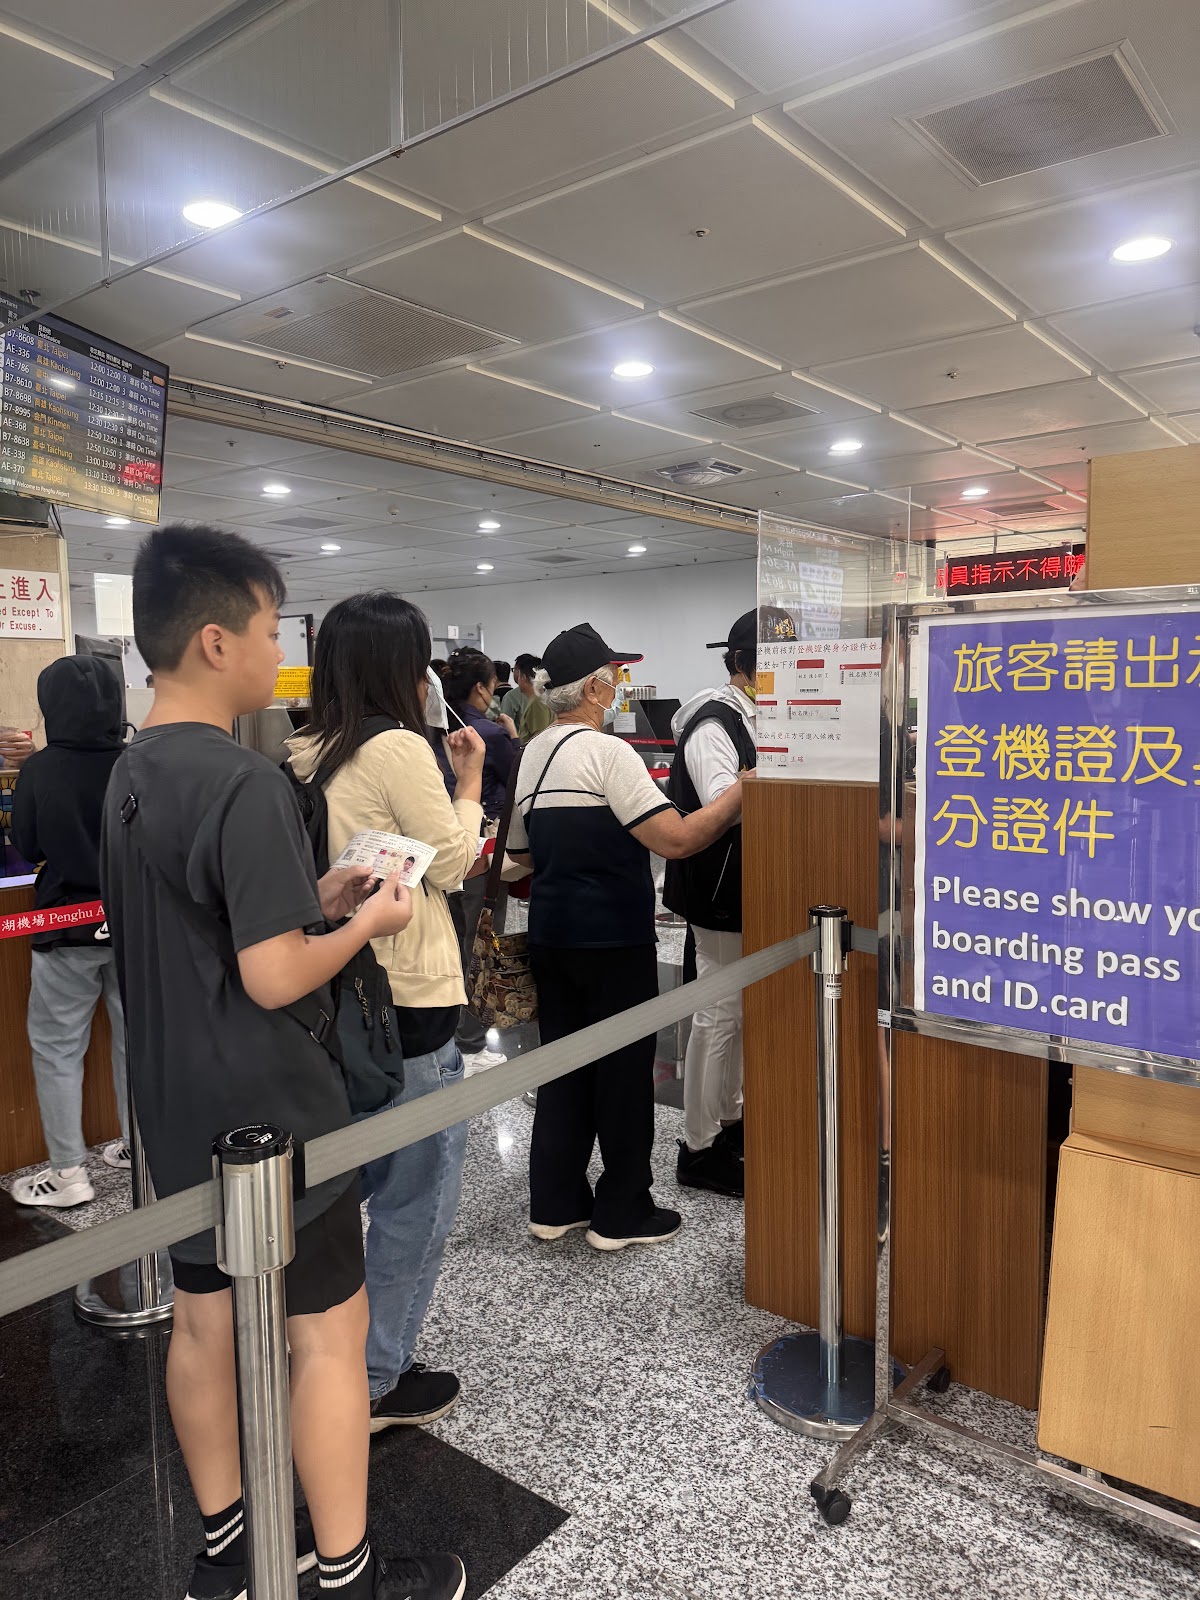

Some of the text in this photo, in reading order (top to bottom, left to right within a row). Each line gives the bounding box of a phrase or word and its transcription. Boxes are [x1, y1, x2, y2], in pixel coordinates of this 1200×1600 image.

[6, 342, 30, 359] AE-336
[37, 354, 49, 367] 高雄
[51, 360, 81, 380] Kaohsiung
[90, 375, 104, 388] 12:00
[106, 382, 120, 393] 12:00
[122, 388, 126, 396] 3
[140, 395, 147, 404] On
[148, 398, 159, 408] Time
[6, 358, 29, 374] AE-786
[90, 389, 104, 401] 12:15
[106, 395, 119, 406] 12:15
[139, 408, 146, 416] On
[147, 411, 159, 420] Time
[51, 346, 69, 362] Taipei
[91, 362, 105, 375] 12:00
[107, 369, 121, 381] 12:00
[123, 375, 127, 383] 9
[141, 383, 148, 391] On
[148, 386, 160, 396] Time
[4, 402, 31, 418] B7-8995
[34, 412, 47, 423] 金門
[48, 416, 71, 430] Kinmen
[88, 429, 102, 440] 12:50
[103, 434, 117, 445] 12:50
[137, 445, 144, 453] On
[145, 447, 157, 456] Time
[5, 373, 32, 390] B7-8610
[50, 388, 67, 403] Taipei
[89, 402, 103, 414] 12:30
[138, 420, 145, 428] On
[146, 423, 158, 433] Time
[5, 388, 32, 404] B7-8698
[35, 398, 47, 410] 高雄
[49, 403, 79, 421] Kaohsiung
[88, 416, 102, 427] 12:30
[104, 421, 118, 432] 12:30
[138, 432, 145, 441] On
[146, 435, 157, 445] Time
[3, 417, 27, 431] AE-368
[48, 431, 65, 444] Taipei
[87, 442, 101, 453] 12:50
[103, 447, 116, 457] 12:50
[136, 457, 144, 465] On
[144, 459, 156, 468] Time
[3, 432, 30, 447] B7-8638
[47, 444, 73, 460] Taichung
[86, 456, 101, 466] 13:00
[102, 460, 116, 470] 13:00
[144, 472, 155, 480] Time
[2, 447, 26, 460] AE-338
[32, 455, 44, 465] 高雄
[46, 458, 77, 474] Kaohsiung
[86, 469, 100, 479] 13:10
[102, 473, 115, 483] 13:10
[143, 484, 154, 492] Time
[2, 462, 25, 474] AE-370
[46, 472, 63, 484] Taipei
[85, 482, 99, 492] 13:30
[101, 486, 114, 495] 13:30
[134, 494, 142, 502] On
[142, 496, 154, 504] Time
[12, 606, 40, 619] Except
[45, 608, 54, 618] To
[934, 724, 1200, 787] 登機證及
[932, 794, 1115, 858] 分證件
[1, 914, 46, 932] 湖機場
[48, 908, 93, 924] Penghu
[932, 875, 1040, 913] Please
[1051, 887, 1152, 925] show
[932, 921, 1181, 982] boarding pass
[932, 975, 1128, 1027] and ID.card
